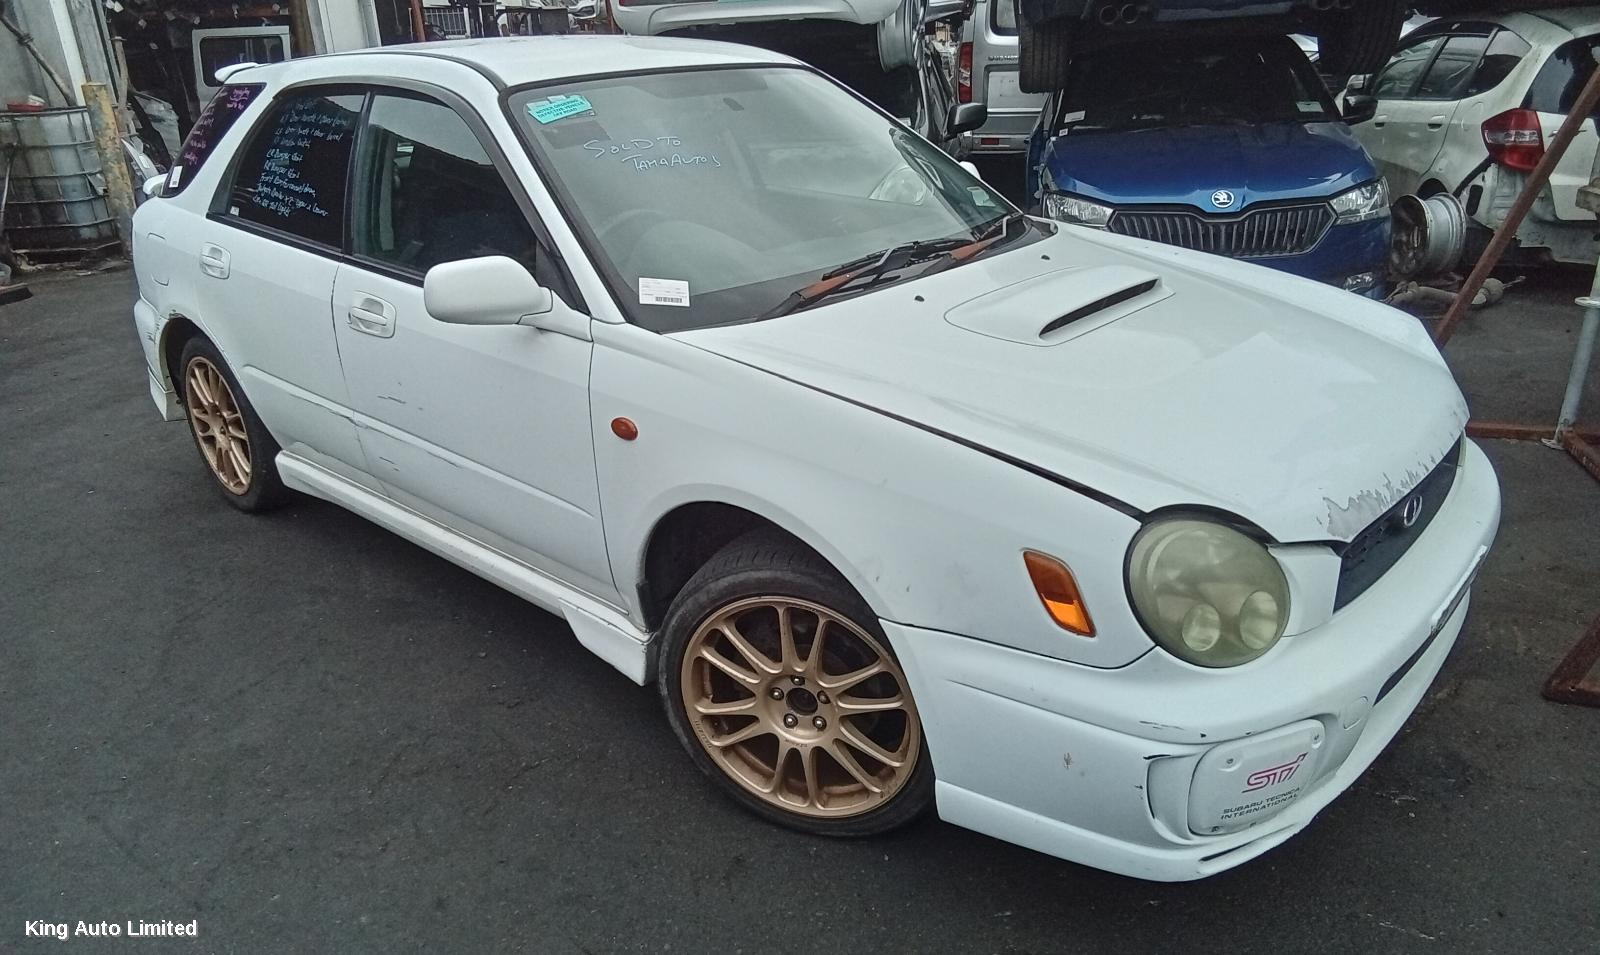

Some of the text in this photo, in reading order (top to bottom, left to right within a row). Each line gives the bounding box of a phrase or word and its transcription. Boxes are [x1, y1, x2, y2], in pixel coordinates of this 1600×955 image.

[1220, 793, 1298, 820] INTERNATIONAL
[1223, 787, 1300, 814] SUBARU TECNICA
